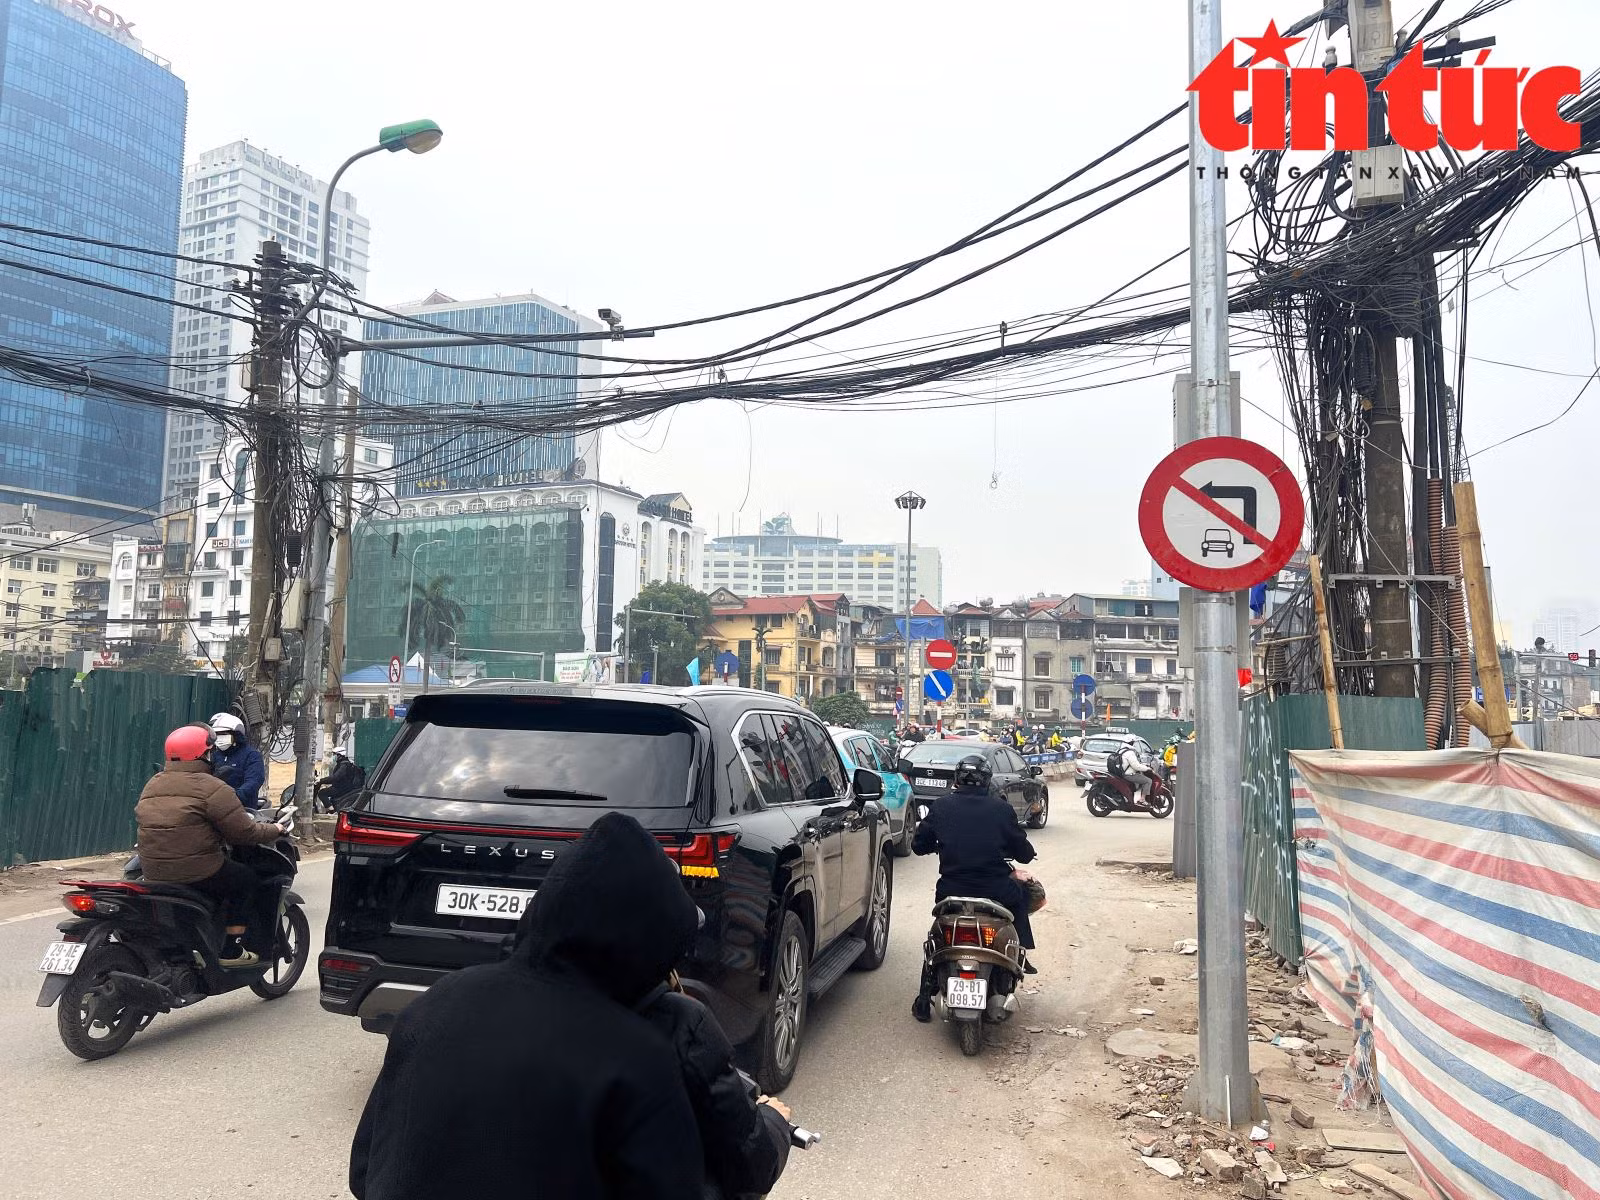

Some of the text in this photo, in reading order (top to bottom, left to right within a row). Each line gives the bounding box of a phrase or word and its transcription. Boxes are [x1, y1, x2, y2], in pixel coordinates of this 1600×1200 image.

[440, 843, 555, 860] LEXUS
[50, 944, 80, 958] 29-AE
[40, 957, 75, 972] 261.34
[953, 980, 981, 993] 29-B1
[950, 993, 984, 1007] 098.57
